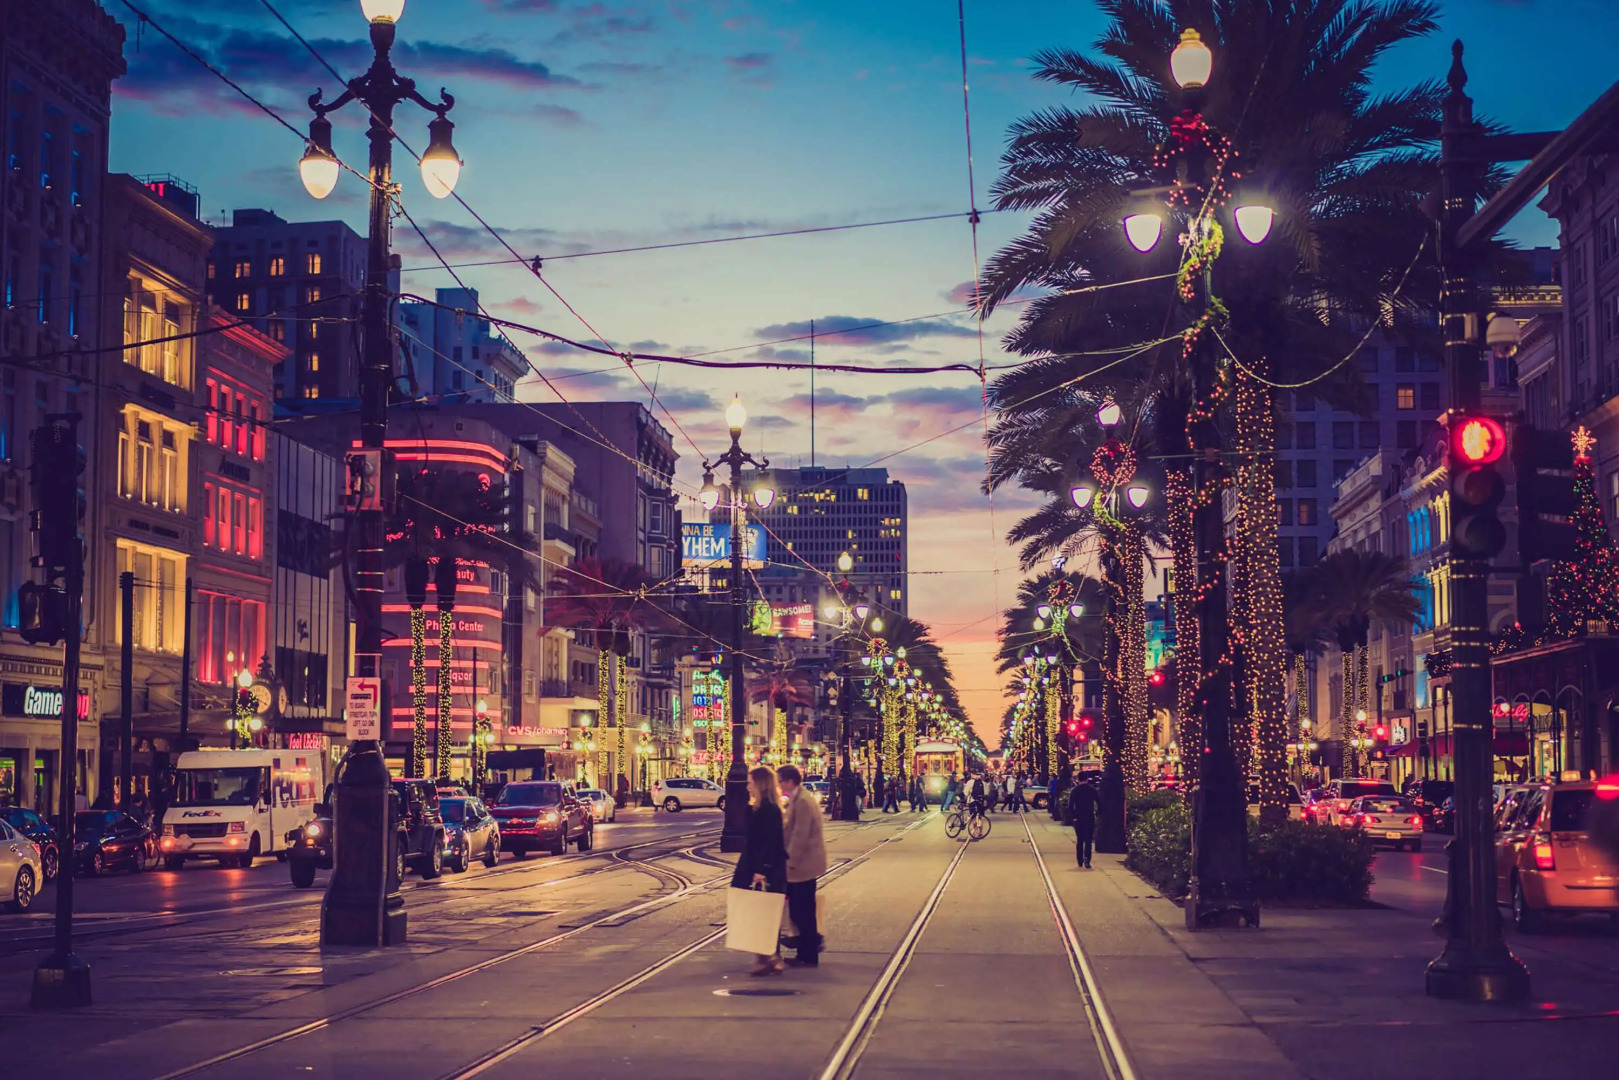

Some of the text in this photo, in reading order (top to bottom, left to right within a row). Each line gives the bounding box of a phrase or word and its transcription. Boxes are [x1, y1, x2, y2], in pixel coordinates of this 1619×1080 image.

[703, 525, 713, 536] BE
[455, 569, 475, 582] auty
[425, 619, 484, 632] Pho Center
[449, 669, 473, 683] iquor
[24, 686, 91, 720] Gamep
[289, 733, 302, 749] Foot
[182, 810, 222, 818] FedEx
